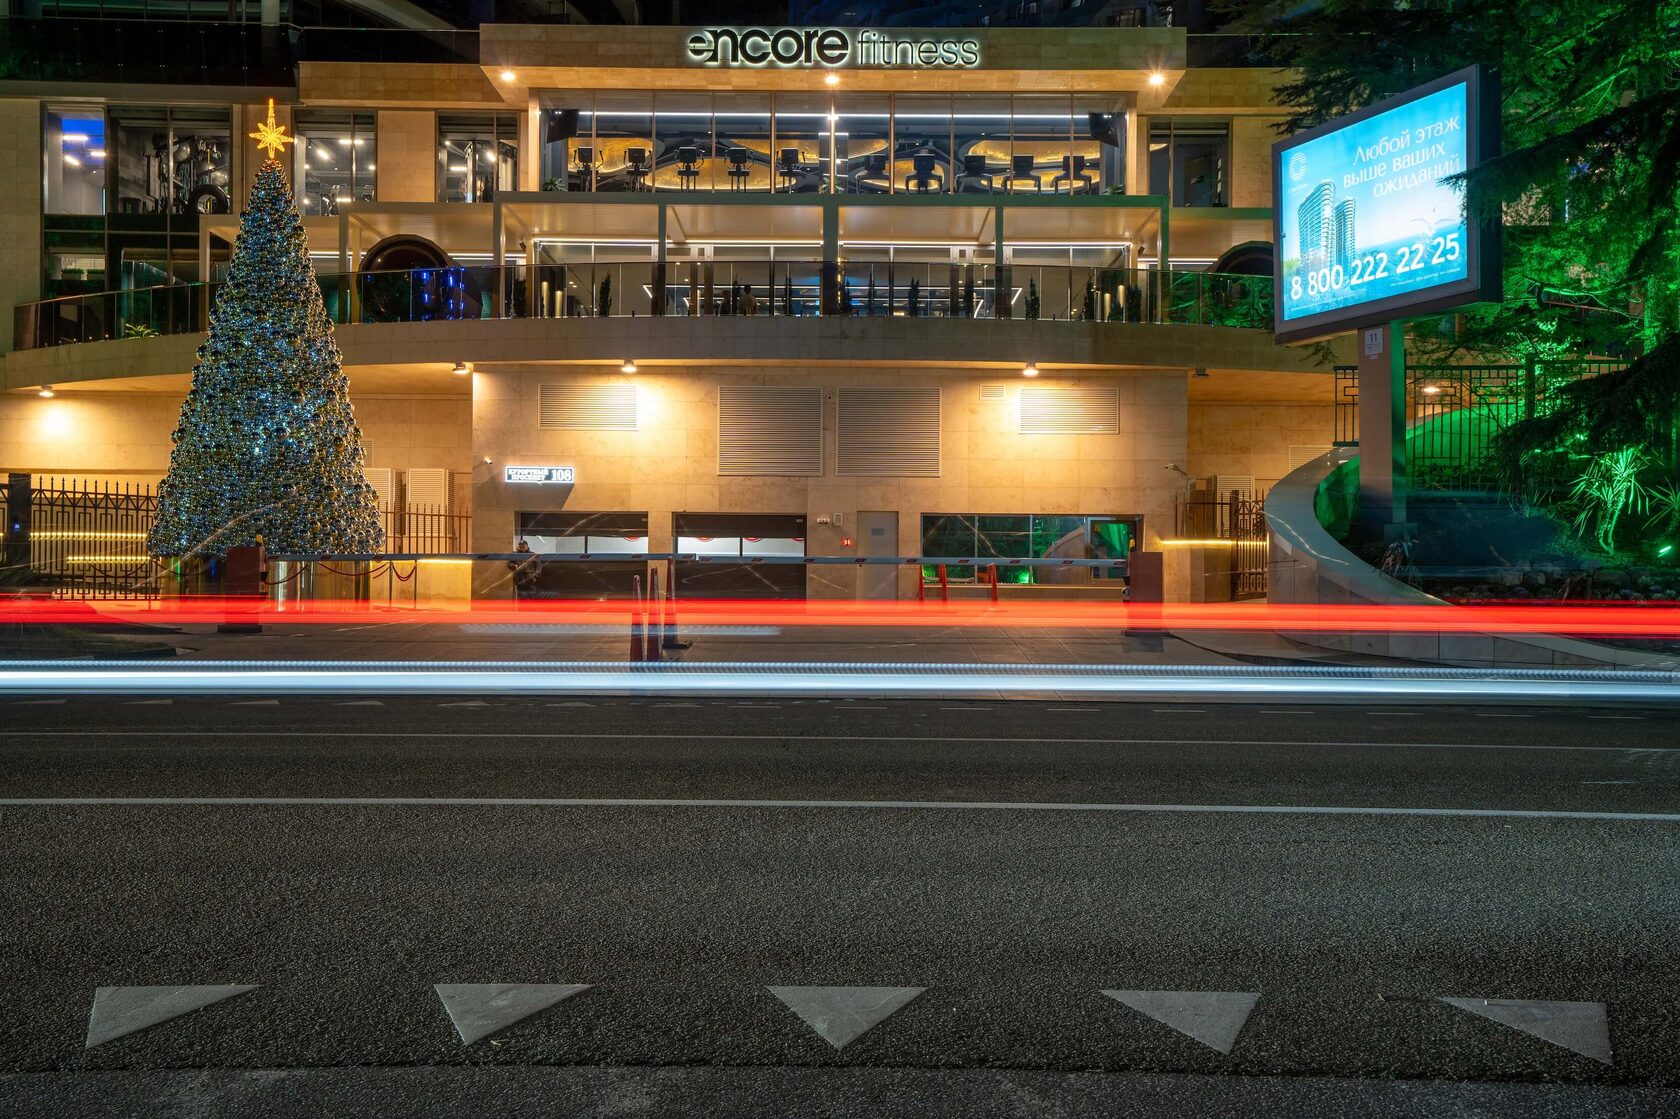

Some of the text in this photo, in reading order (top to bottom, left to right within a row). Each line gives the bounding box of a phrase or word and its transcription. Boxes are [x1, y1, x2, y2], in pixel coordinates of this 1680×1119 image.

[688, 29, 978, 65] encore fitness
[1353, 115, 1460, 166] Любой этаж
[1343, 142, 1446, 188] выше ваших
[1373, 153, 1460, 197] ожиданий
[1291, 275, 1301, 300] 8
[1307, 265, 1344, 296] 800
[1350, 252, 1388, 285] 222
[1396, 243, 1424, 274] 22
[1431, 233, 1460, 265] 25
[1369, 333, 1377, 343] 11
[551, 469, 572, 481] 108
